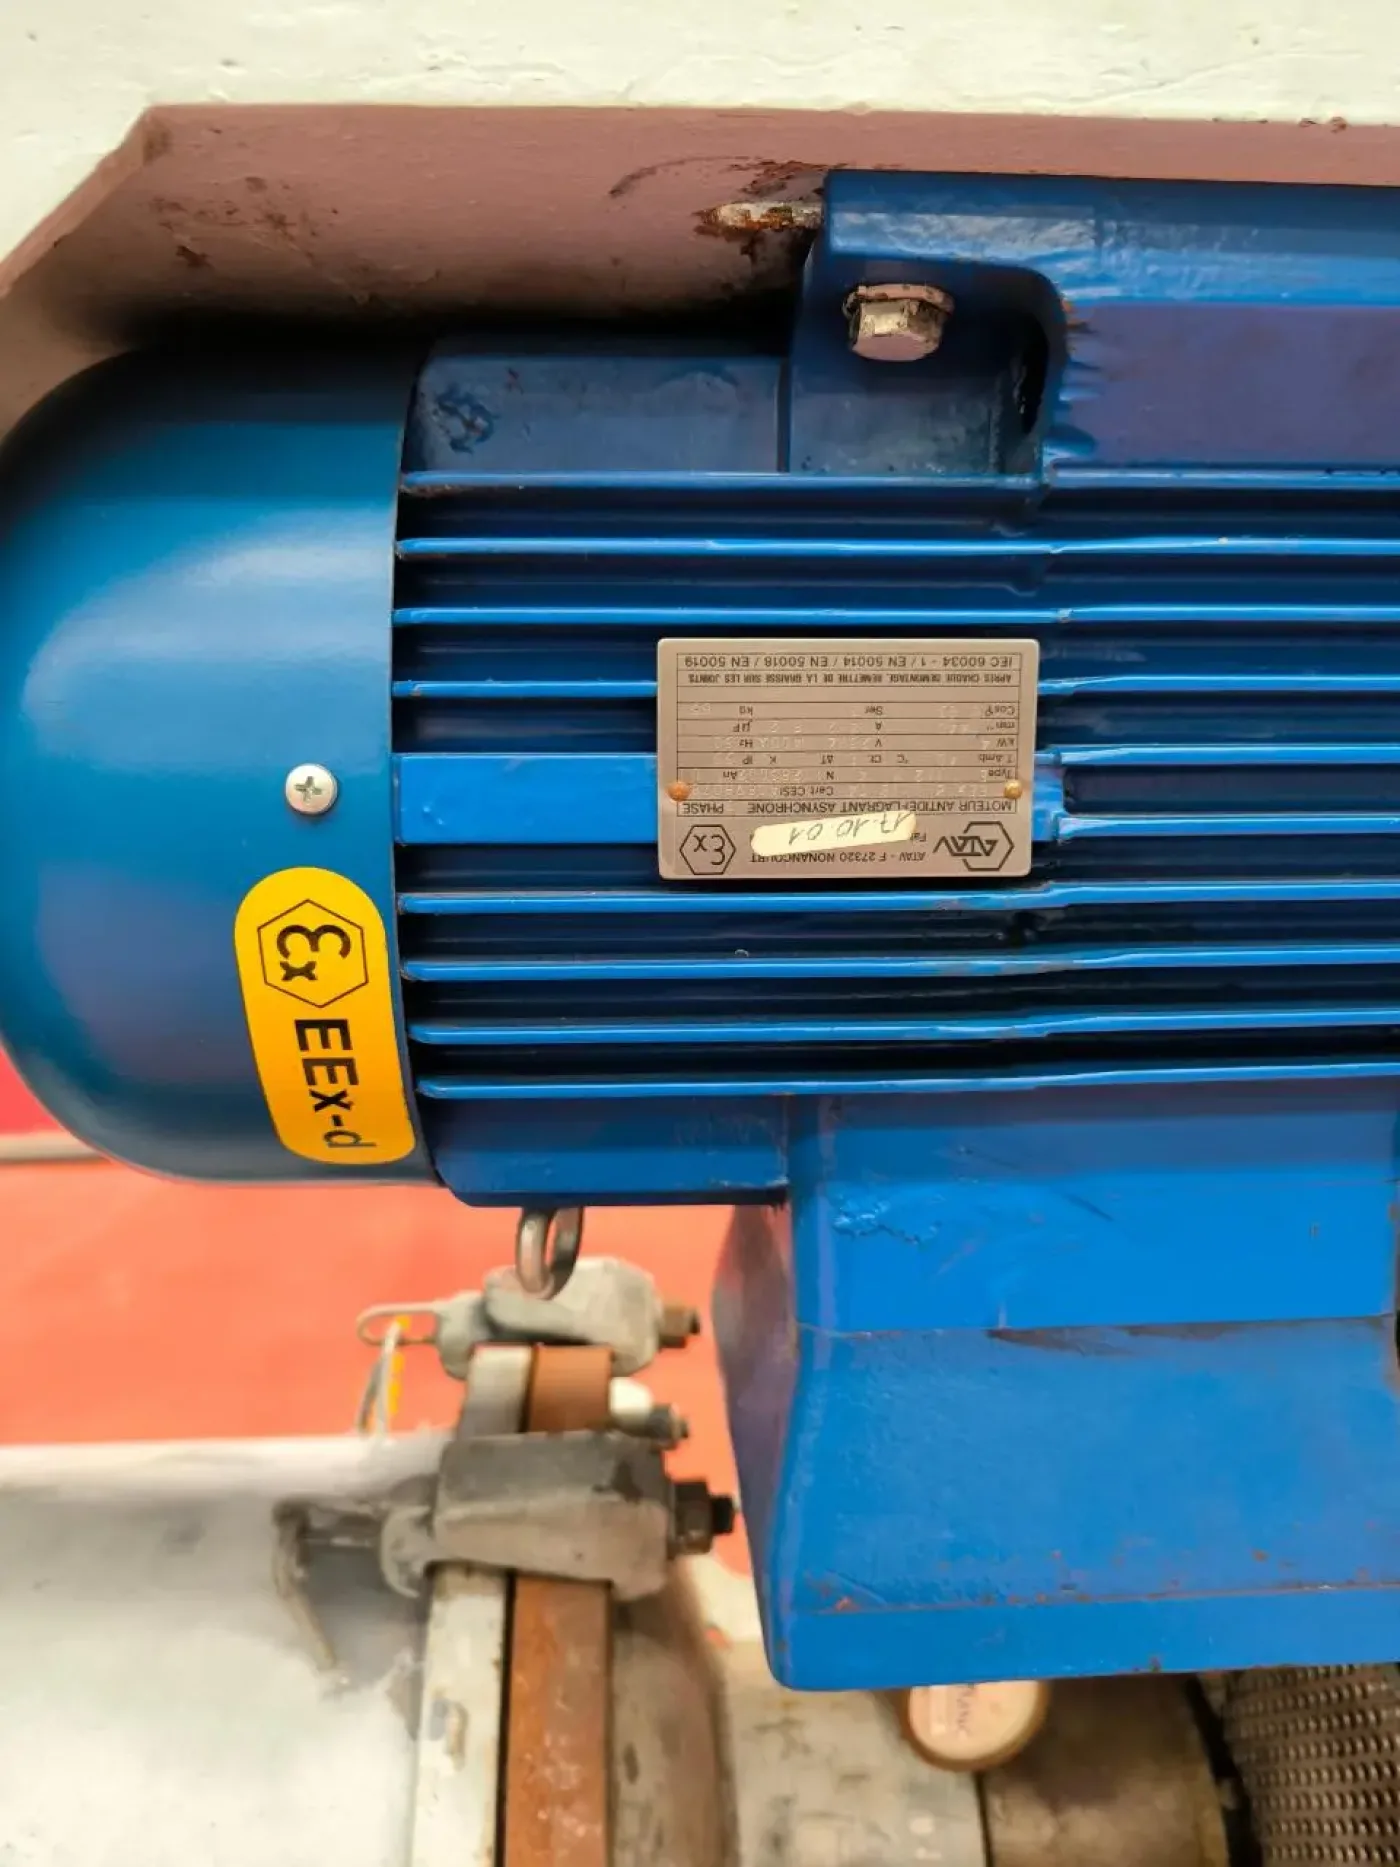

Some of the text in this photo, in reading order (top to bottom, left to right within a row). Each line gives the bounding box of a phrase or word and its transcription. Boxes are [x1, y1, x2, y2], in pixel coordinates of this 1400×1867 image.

[685, 656, 726, 667] 50019
[731, 656, 749, 667] EN
[764, 656, 806, 667] 50018
[810, 656, 828, 667] EN
[843, 656, 884, 667] 50014
[888, 656, 906, 667] EN
[942, 656, 986, 667] 60034
[990, 656, 1012, 667] IEC
[688, 674, 720, 683] JOINTS
[724, 674, 740, 683] LES
[744, 674, 761, 683] SUR
[765, 674, 802, 683] GRAISSE
[806, 674, 818, 683] LA
[823, 674, 833, 683] DE
[838, 674, 882, 683] REMETTRE
[946, 674, 980, 683] CHAQUE
[739, 705, 753, 715] kg
[875, 722, 882, 730] A
[739, 739, 753, 747] Hz
[875, 739, 882, 747] V
[996, 738, 1015, 748] kW
[742, 756, 753, 764] IP
[769, 756, 776, 764] K
[722, 771, 737, 780] An
[988, 768, 1010, 778] Type
[780, 786, 806, 796] CESI
[682, 800, 1012, 814] MOTEUR ANTIDEFLAGRANT ASYNCHRONE PHASE
[932, 836, 998, 856] ATAV
[840, 852, 876, 862] 27320
[880, 852, 886, 862] F
[898, 852, 926, 862] ATAV
[293, 1018, 378, 1149] EEx-d
